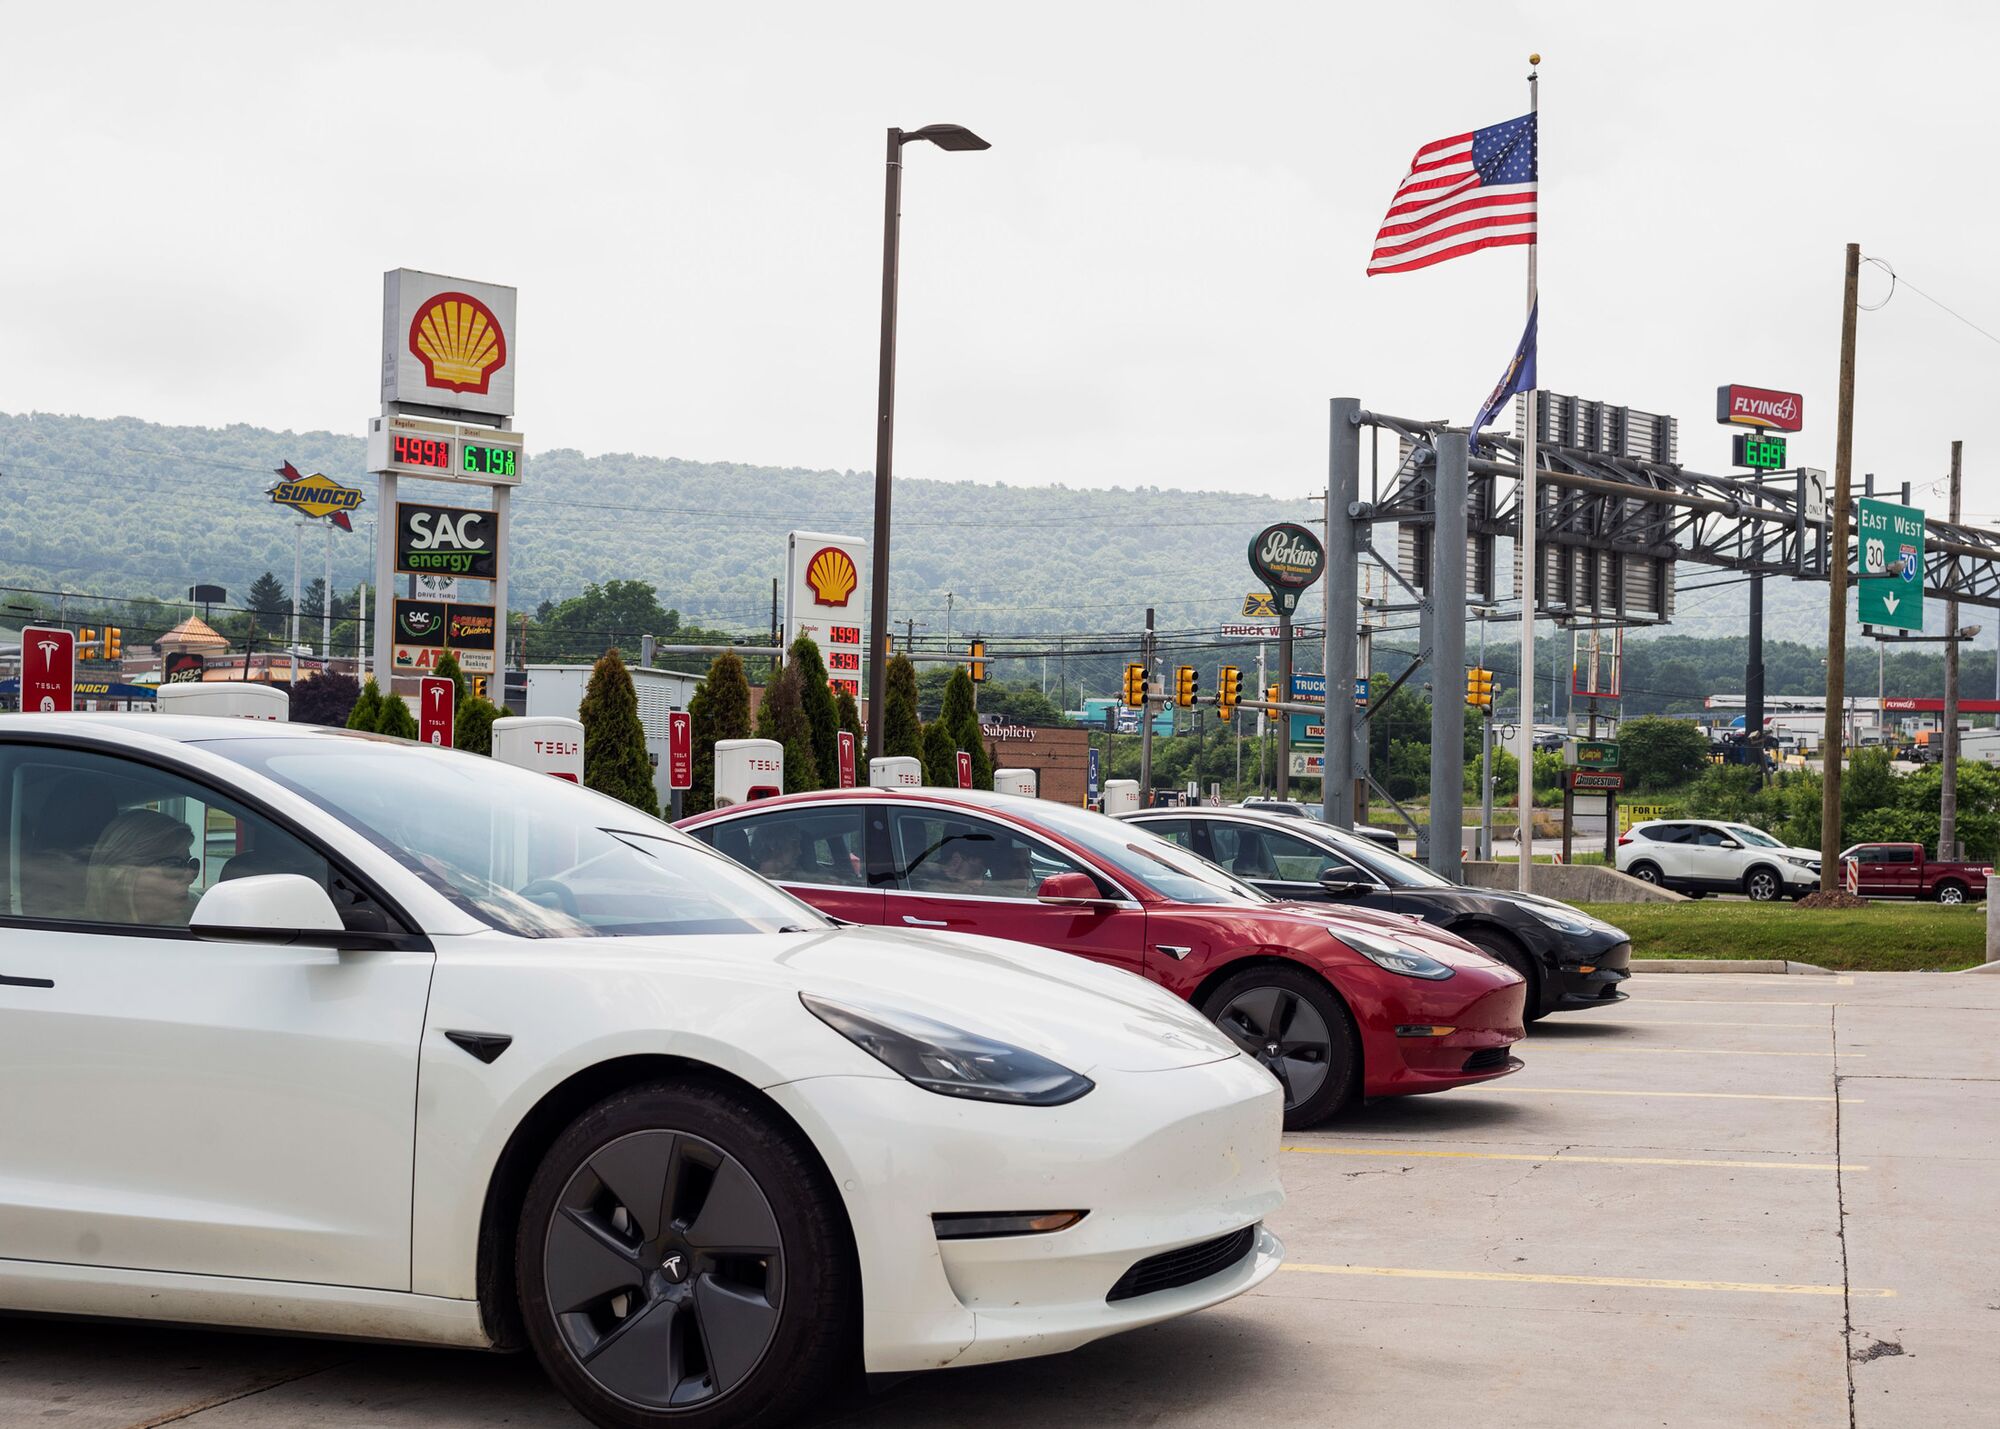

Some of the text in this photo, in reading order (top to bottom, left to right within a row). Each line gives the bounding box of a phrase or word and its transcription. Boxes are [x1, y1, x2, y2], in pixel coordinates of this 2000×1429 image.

[1735, 397, 1782, 416] FLYING
[395, 419, 416, 428] Regular
[464, 446, 504, 474] 6.19
[1747, 441, 1780, 468] 6.89
[277, 485, 359, 506] SUNOCO
[1808, 504, 1823, 516] ONLY
[1861, 509, 1921, 537] EAST WEST
[410, 512, 485, 550] SAC
[1262, 531, 1318, 567] Perkins
[1868, 546, 1883, 567] 30
[409, 554, 472, 572] energy
[1901, 553, 1915, 575] 70
[409, 611, 429, 623] SAC
[1222, 626, 1265, 636] TRUCK
[465, 660, 488, 669] Banking
[170, 668, 202, 683] Pizza
[1296, 680, 1325, 691] TRUCK
[44, 702, 52, 712] 15
[983, 724, 1037, 742] Subplicity
[534, 741, 578, 755] TESLA
[749, 759, 780, 771] TESLA
[1576, 774, 1621, 786] BRIDGESTONE
[1633, 807, 1650, 815] FOR
